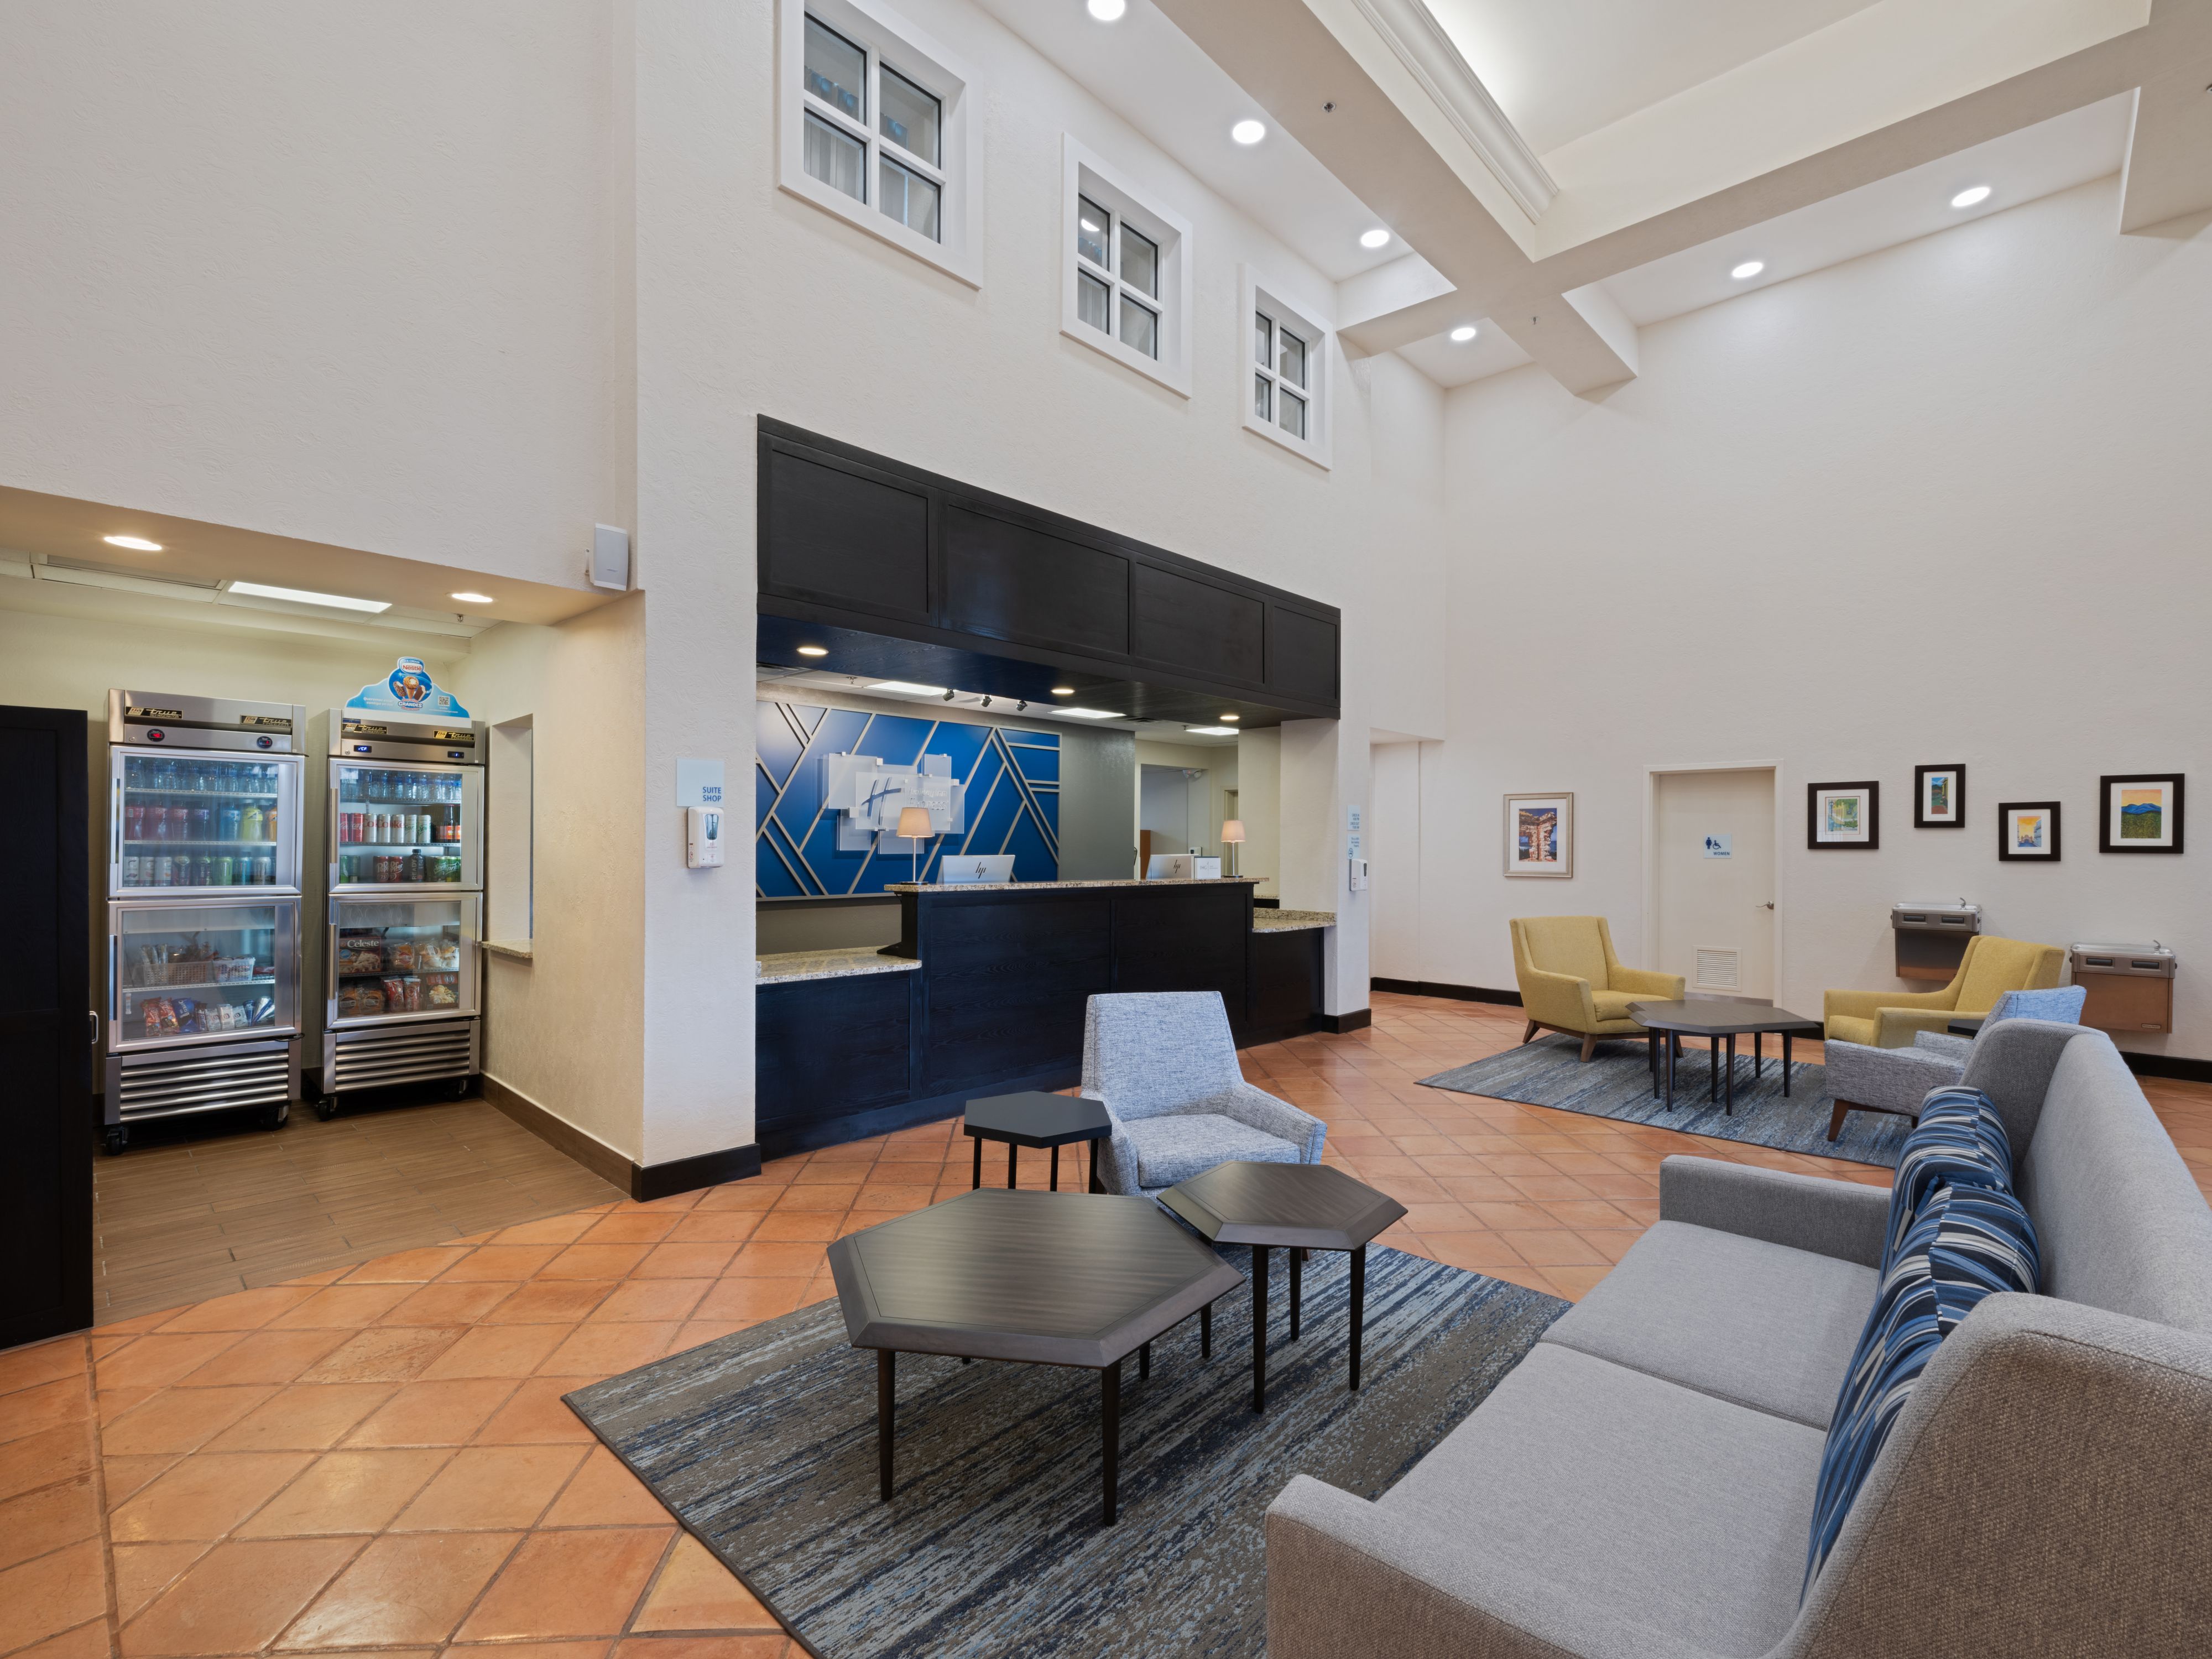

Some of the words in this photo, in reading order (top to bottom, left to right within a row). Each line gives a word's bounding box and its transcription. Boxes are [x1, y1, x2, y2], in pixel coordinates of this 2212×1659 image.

[975, 862, 987, 879] hp
[1173, 859, 1181, 873] hp
[347, 939, 379, 948] Celeste
